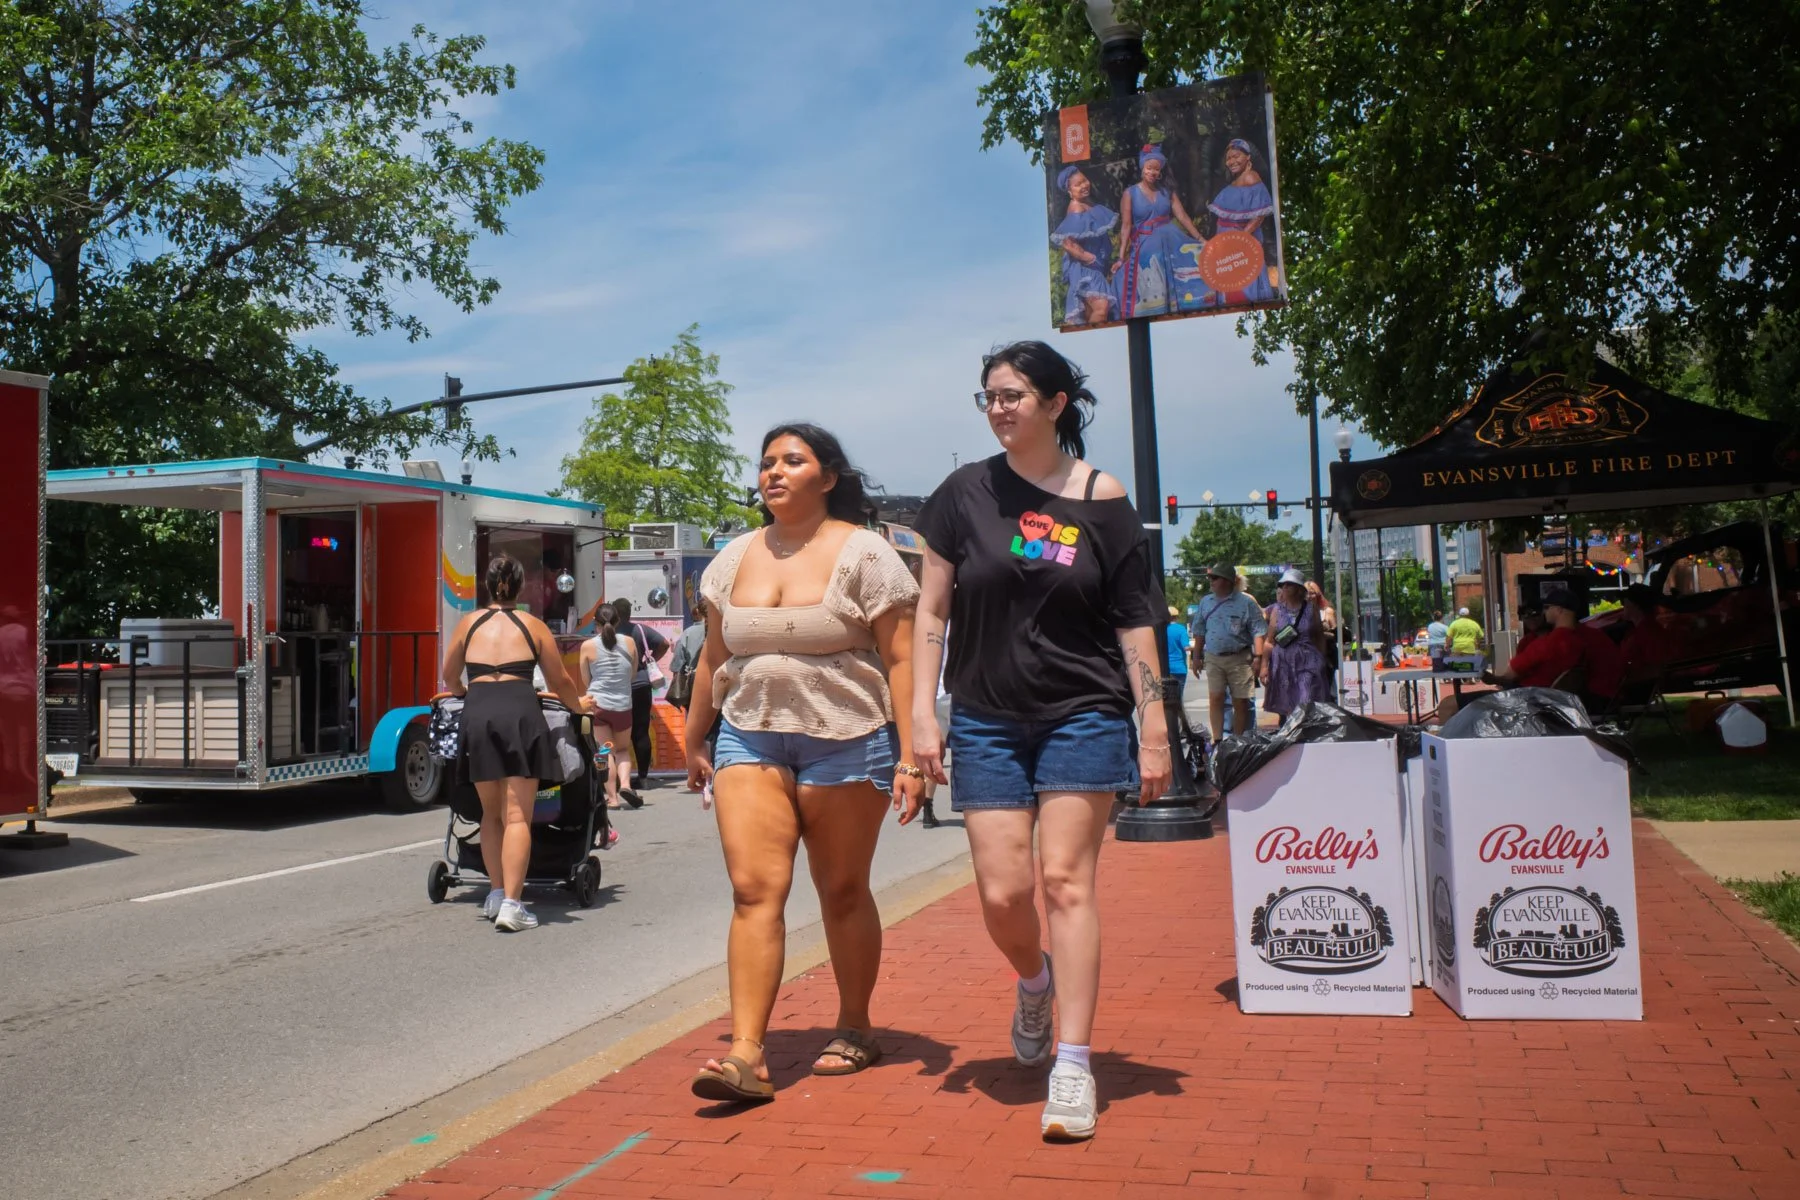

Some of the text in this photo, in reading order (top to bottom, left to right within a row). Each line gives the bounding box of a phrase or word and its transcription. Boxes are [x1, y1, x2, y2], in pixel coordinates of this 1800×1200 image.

[1215, 251, 1245, 266] Haitian
[1215, 257, 1249, 274] Flag Day
[1423, 450, 1736, 487] EVANSVILLE FIRE DEPT
[1023, 519, 1079, 545] LOVE IS
[1010, 535, 1077, 567] LOVE
[1256, 826, 1379, 869] Bally's
[1479, 824, 1610, 869] Bally's
[1285, 865, 1336, 874] EVANSVILLE
[1511, 865, 1565, 875] EVANSVILLE
[1301, 895, 1336, 908] KEEP
[1527, 895, 1564, 909] KEEP
[1278, 908, 1361, 921] EVANSVILLE
[1503, 909, 1590, 922] EVANSVILLE
[1245, 983, 1406, 993] Produced using Recycled Material
[1467, 987, 1638, 998] Produced using Recycled Material
